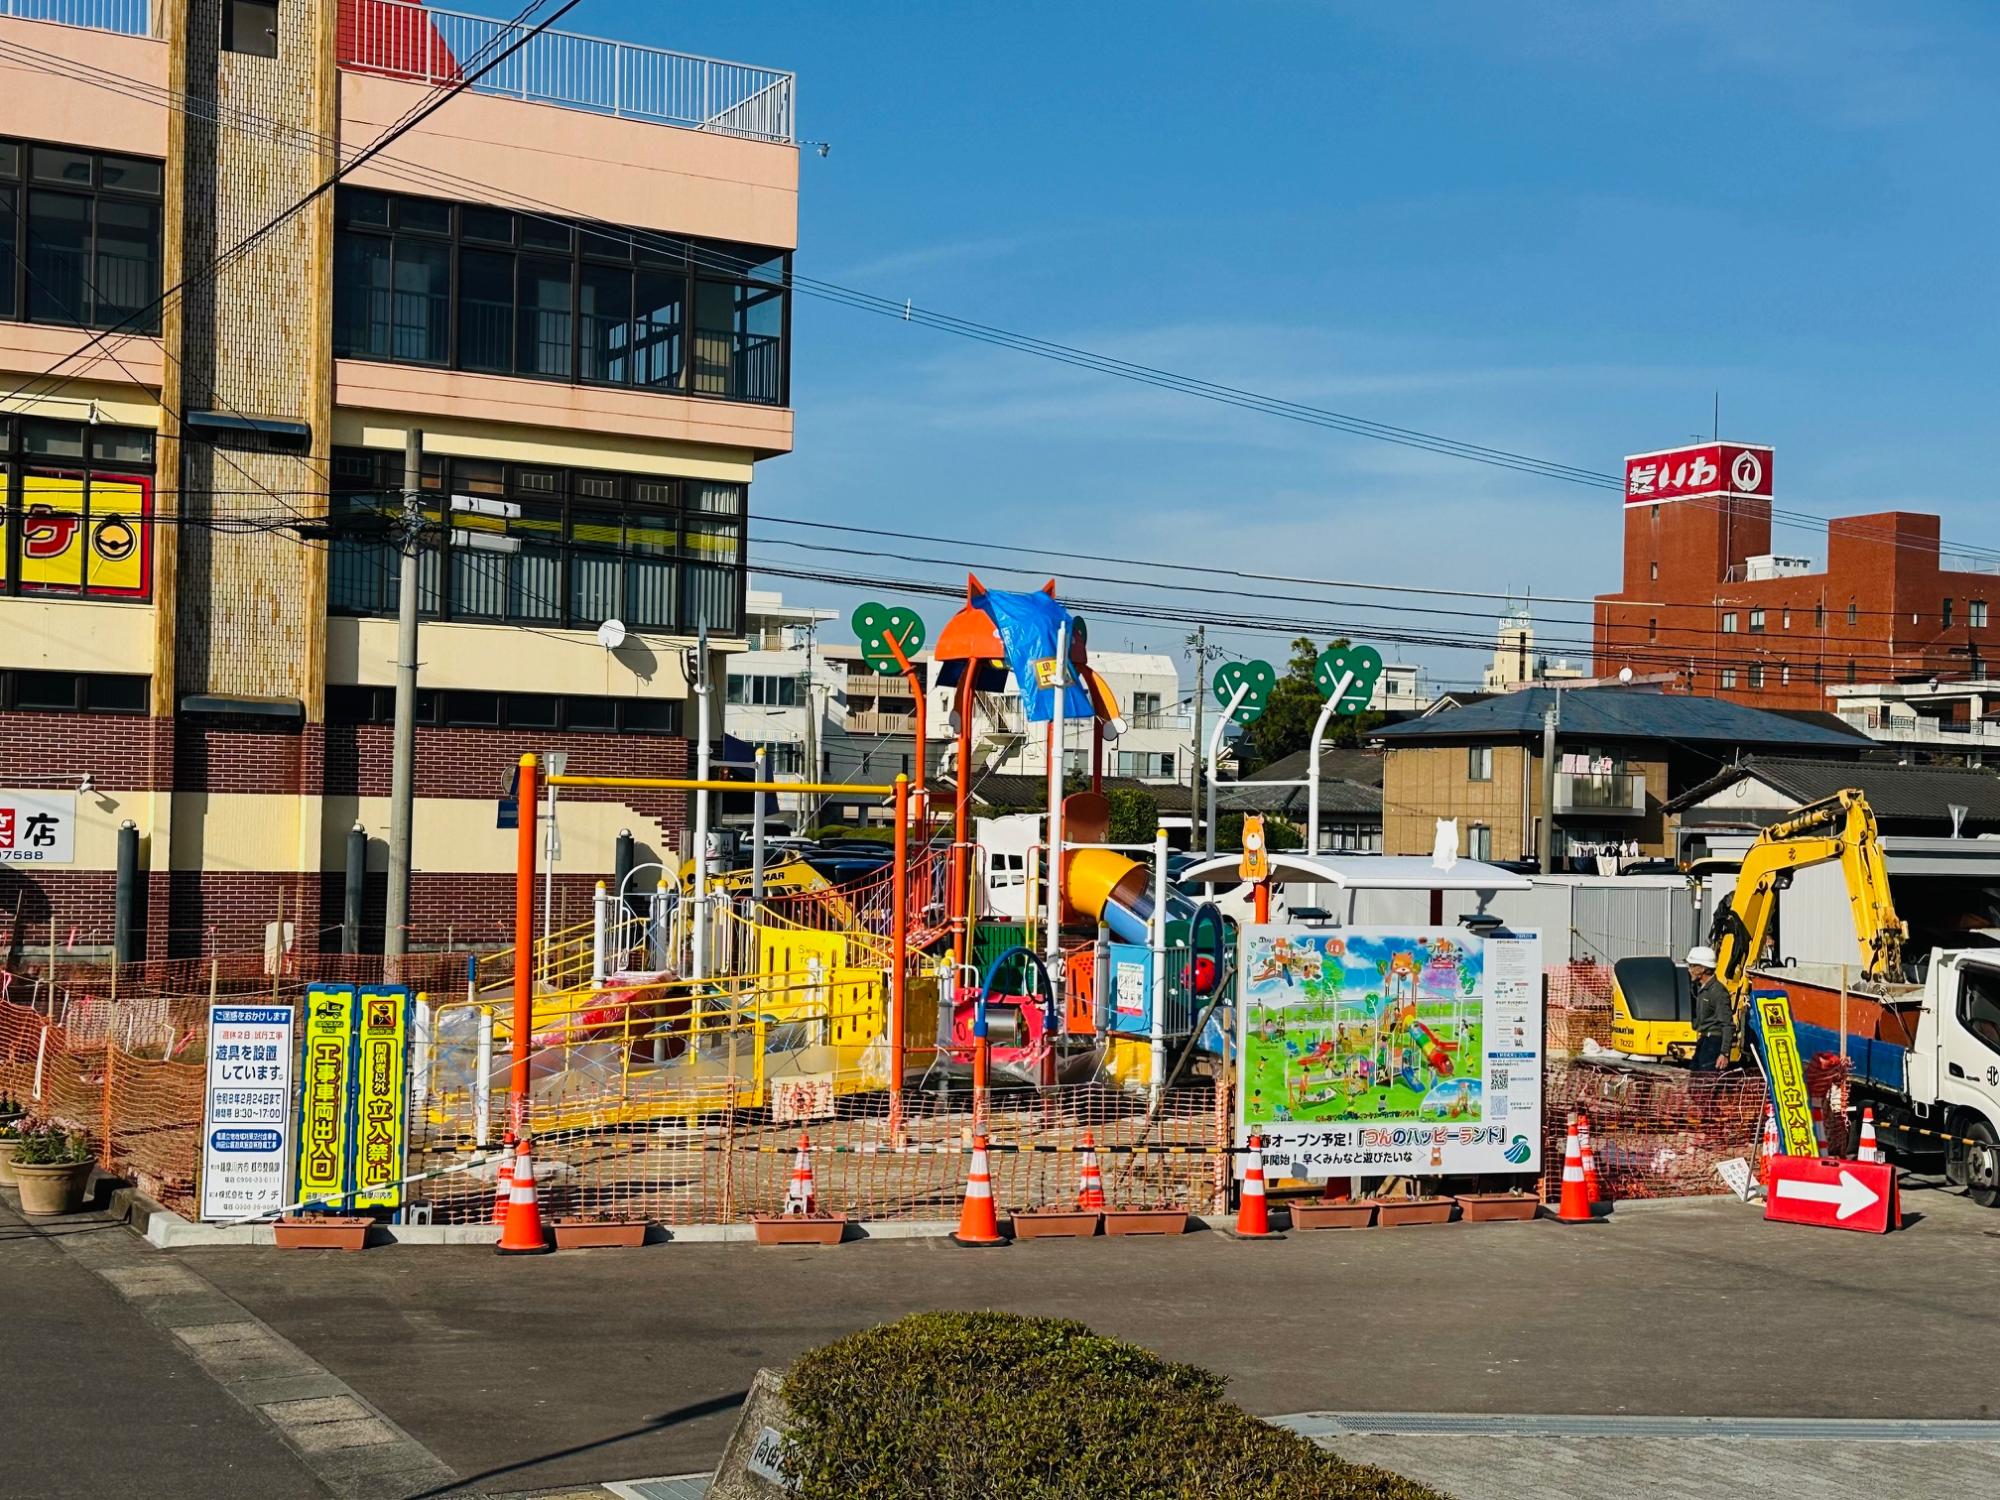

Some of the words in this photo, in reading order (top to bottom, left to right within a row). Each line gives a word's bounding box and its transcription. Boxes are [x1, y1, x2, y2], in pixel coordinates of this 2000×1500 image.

[0, 850, 44, 860] 7688
[737, 871, 785, 885] YAMAR
[215, 1010, 288, 1022] ご迷惑をおかけします
[215, 1045, 277, 1061] 遊具を設置
[222, 1065, 283, 1081] しています。
[311, 1044, 341, 1180] 工事車両出入口
[367, 1099, 393, 1185] 立入禁止
[1247, 1132, 1352, 1148] 春オープン予定!
[1302, 1151, 1413, 1166] 早くみんなと遊びたいな
